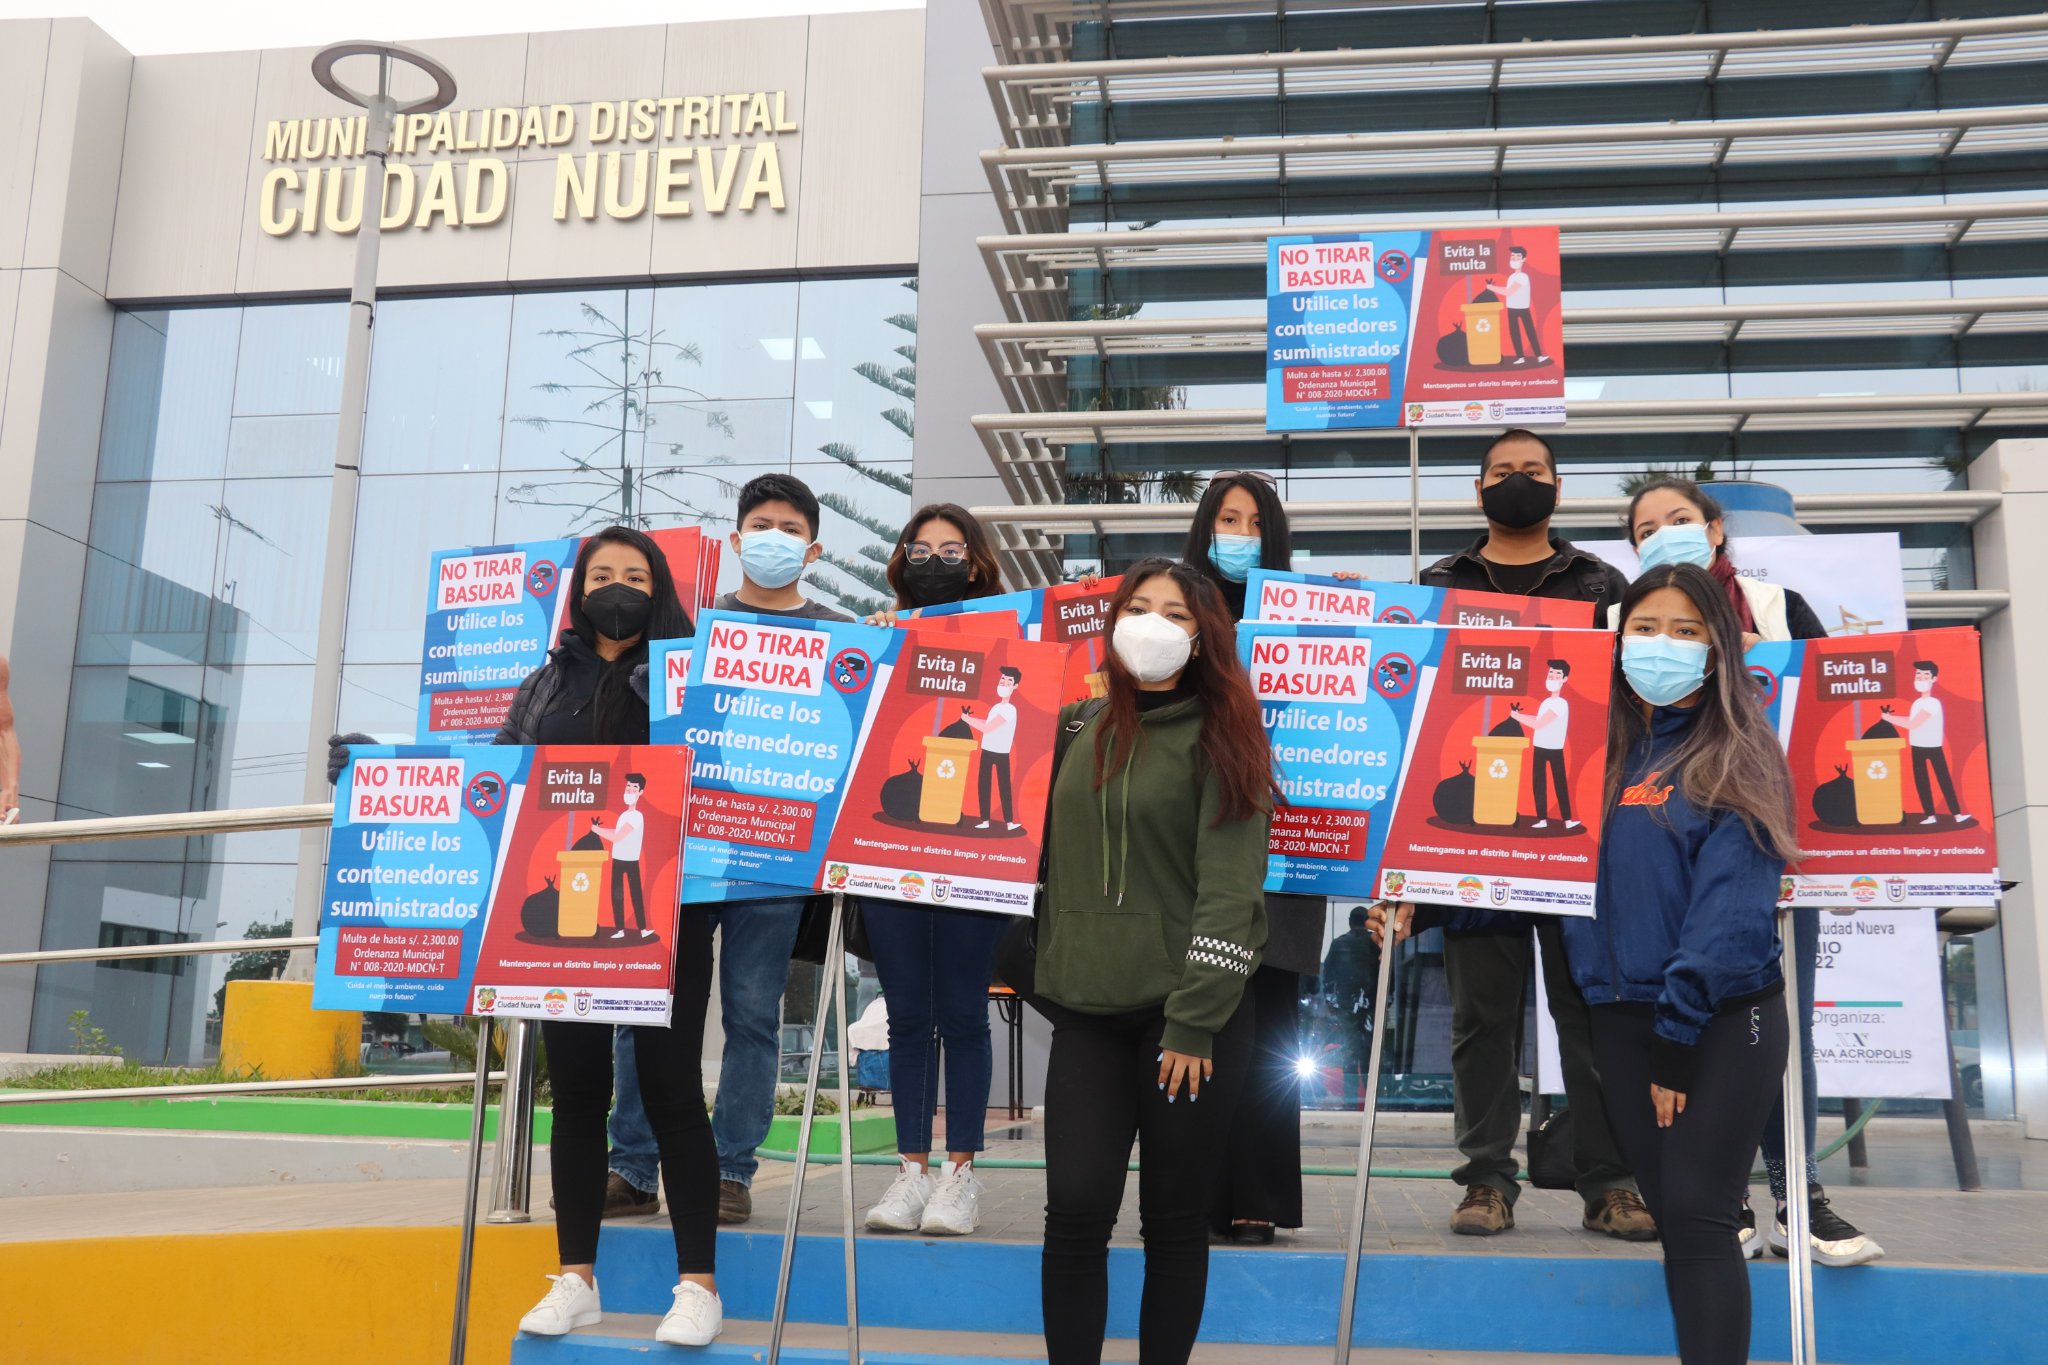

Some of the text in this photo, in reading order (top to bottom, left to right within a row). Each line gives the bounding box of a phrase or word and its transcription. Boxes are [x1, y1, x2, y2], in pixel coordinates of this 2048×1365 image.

[264, 90, 798, 161] MUNIIPALIDAD DISTRITAL
[259, 141, 786, 237] CIUDAD NUEVA
[1280, 247, 1371, 265] NO TIRAR
[1444, 246, 1491, 258] Evita la
[1449, 258, 1486, 271] multa
[1287, 268, 1366, 286] BASURA
[1292, 294, 1379, 313] Utilice los
[1274, 317, 1397, 337] contenedores
[1273, 342, 1400, 361] suministrados
[1322, 370, 1341, 378] hasta
[1356, 368, 1386, 377] 2,300.00
[1298, 379, 1376, 389] Ordenanza Municipal
[1308, 389, 1377, 398] 008-2020-MDCN-T
[441, 557, 522, 581] NO TIRAR
[444, 585, 515, 604] BASURA
[1263, 586, 1370, 616] NO TIRAR
[1061, 599, 1111, 620] Evita la
[446, 611, 524, 632] Utilice los
[1459, 612, 1512, 627] Evita la
[428, 637, 538, 659] contenedores
[710, 626, 825, 659] NO TIRAR
[1254, 643, 1366, 666] NO TIRAR
[1462, 653, 1521, 669] Evita la
[713, 656, 812, 688] BASURA
[917, 654, 976, 675] Evita la
[1823, 658, 1887, 676] Evita la
[920, 676, 967, 693] multa
[1259, 672, 1356, 696] BASURA
[1466, 672, 1513, 688] multa
[1830, 678, 1881, 695] multa
[496, 693, 513, 702] 2,300
[443, 705, 509, 716] Ordenanza Municipa
[714, 693, 821, 724] Utilice los
[451, 716, 506, 726] 008-2020-MDCN
[1262, 708, 1368, 732] Utilice los
[685, 727, 839, 760] contenedores
[1274, 743, 1387, 766] tenedores
[354, 765, 460, 788] NO TIRAR
[547, 768, 602, 785] Evita la
[691, 760, 835, 794] uministrados
[551, 787, 595, 804] multa
[359, 794, 451, 817] BASURA
[689, 794, 812, 818] Multa de hasta s/. 2,300.00
[698, 810, 796, 832] Ordenanza Municipal
[1284, 812, 1365, 827] hasta s/. 2,300.00
[361, 831, 461, 851] Utilice los
[693, 823, 795, 844] N° 008-2020-MDCN-T
[1270, 829, 1349, 842] enanza Municipal
[854, 838, 908, 851] Mantengamos
[924, 846, 952, 856] distrito
[954, 851, 979, 860] limpio
[989, 854, 1026, 864] ordenado
[1269, 840, 1350, 854] 08-2020-MDCN-T
[1409, 844, 1465, 855] Mantengamos
[1481, 848, 1509, 857] distrito
[1512, 850, 1538, 860] limpio
[1548, 853, 1588, 862] ordenado
[1870, 847, 1900, 855] distrito
[1904, 847, 1931, 856] limpio
[336, 864, 479, 886] contenedores
[850, 879, 896, 891] Ciudad Nueva
[1407, 885, 1454, 896] Ciudad Nueva
[331, 898, 478, 919] suministrados
[1819, 922, 1895, 934] iudad Nueva
[342, 934, 459, 946] Multa de hasta s/. 2,300.00
[354, 948, 444, 961] Ordenanza Municipal
[350, 962, 445, 973] N° 008-2020-MDCN-T
[499, 960, 550, 969] Mantengamos
[565, 960, 591, 969] distrito
[593, 961, 616, 971] limpio
[625, 962, 661, 970] ordenado
[497, 1001, 520, 1009] Ciudad
[1840, 1049, 1912, 1058] ACROPOLIS
